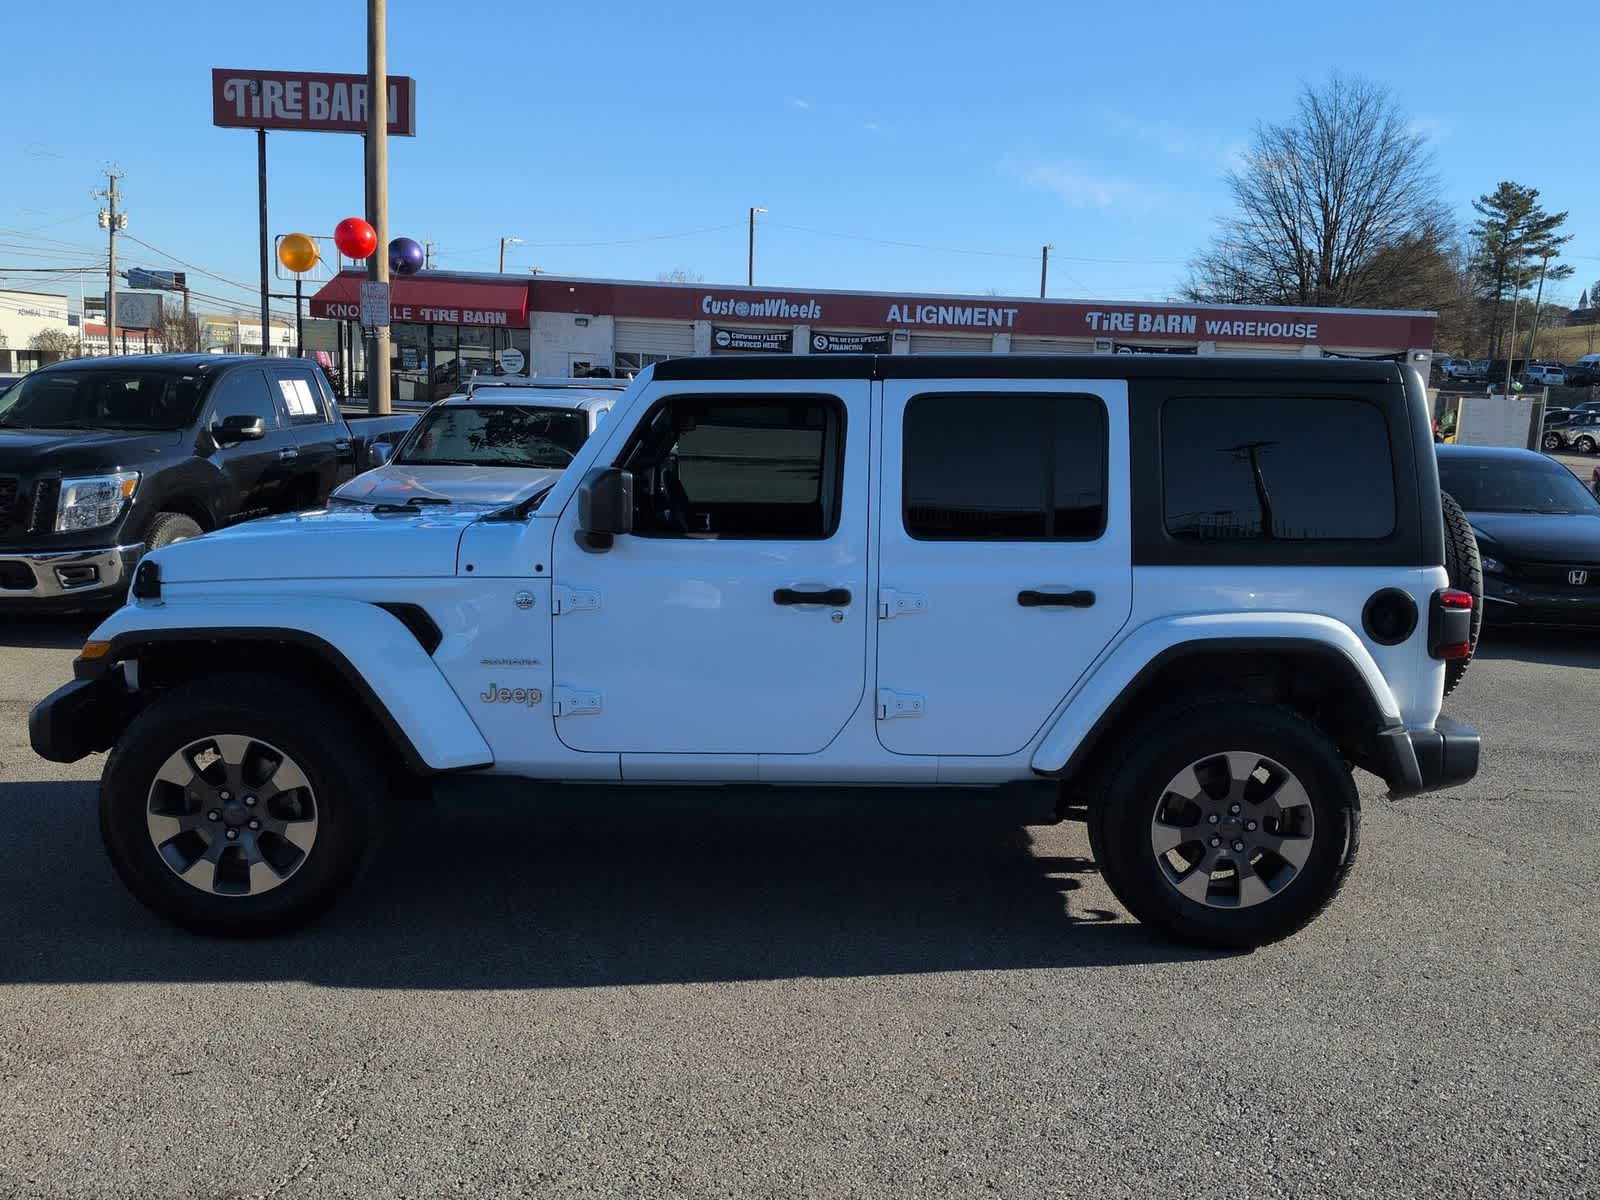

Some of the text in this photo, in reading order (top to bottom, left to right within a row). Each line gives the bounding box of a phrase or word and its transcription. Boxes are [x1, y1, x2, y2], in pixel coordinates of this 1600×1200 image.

[326, 303, 411, 320] KNOLE
[463, 309, 507, 325] BARN
[886, 303, 1018, 327] ALIGNMENT
[1138, 312, 1197, 334] BARN
[1205, 320, 1318, 339] WAREHOUSE
[731, 340, 762, 349] SERVICED
[828, 343, 863, 351] FINANCING
[480, 682, 543, 708] Jeep
